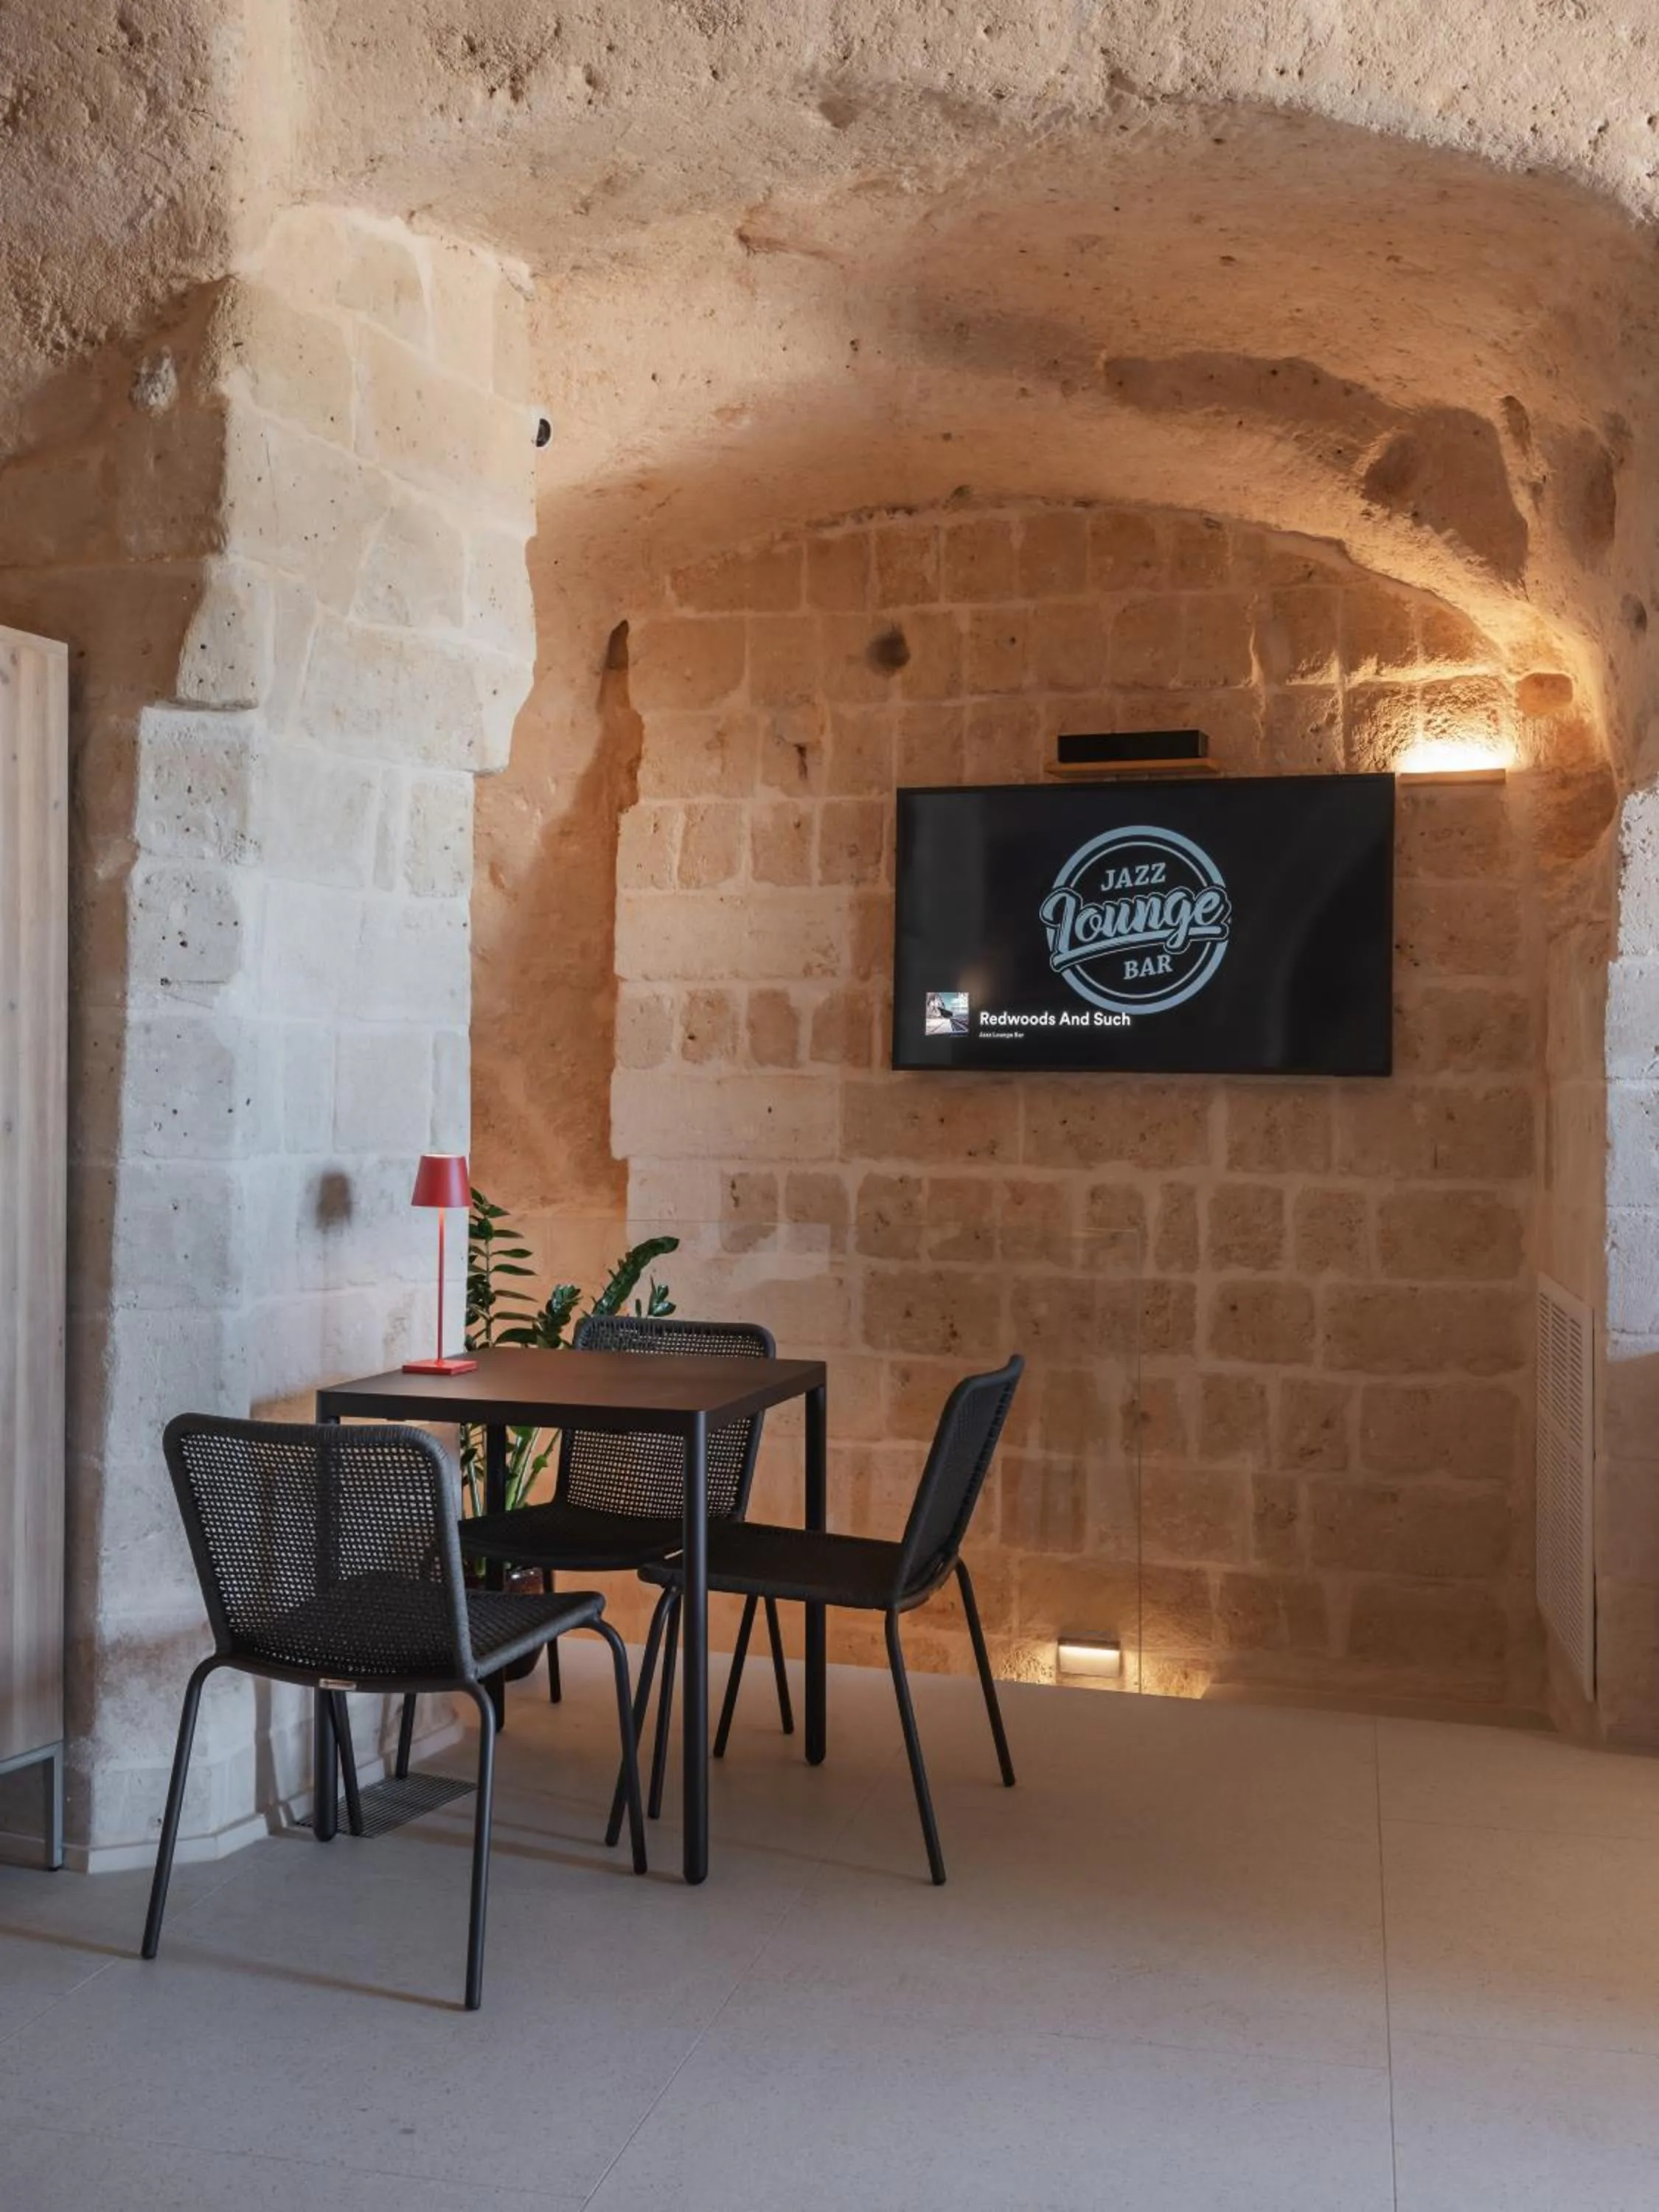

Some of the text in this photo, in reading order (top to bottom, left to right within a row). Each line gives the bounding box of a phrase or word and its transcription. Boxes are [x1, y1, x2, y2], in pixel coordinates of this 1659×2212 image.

[1101, 862, 1166, 891] JAZZ
[1041, 890, 1225, 965] Lounge
[1124, 955, 1172, 980] BAR
[979, 1011, 1130, 1026] Redwoods And Such
